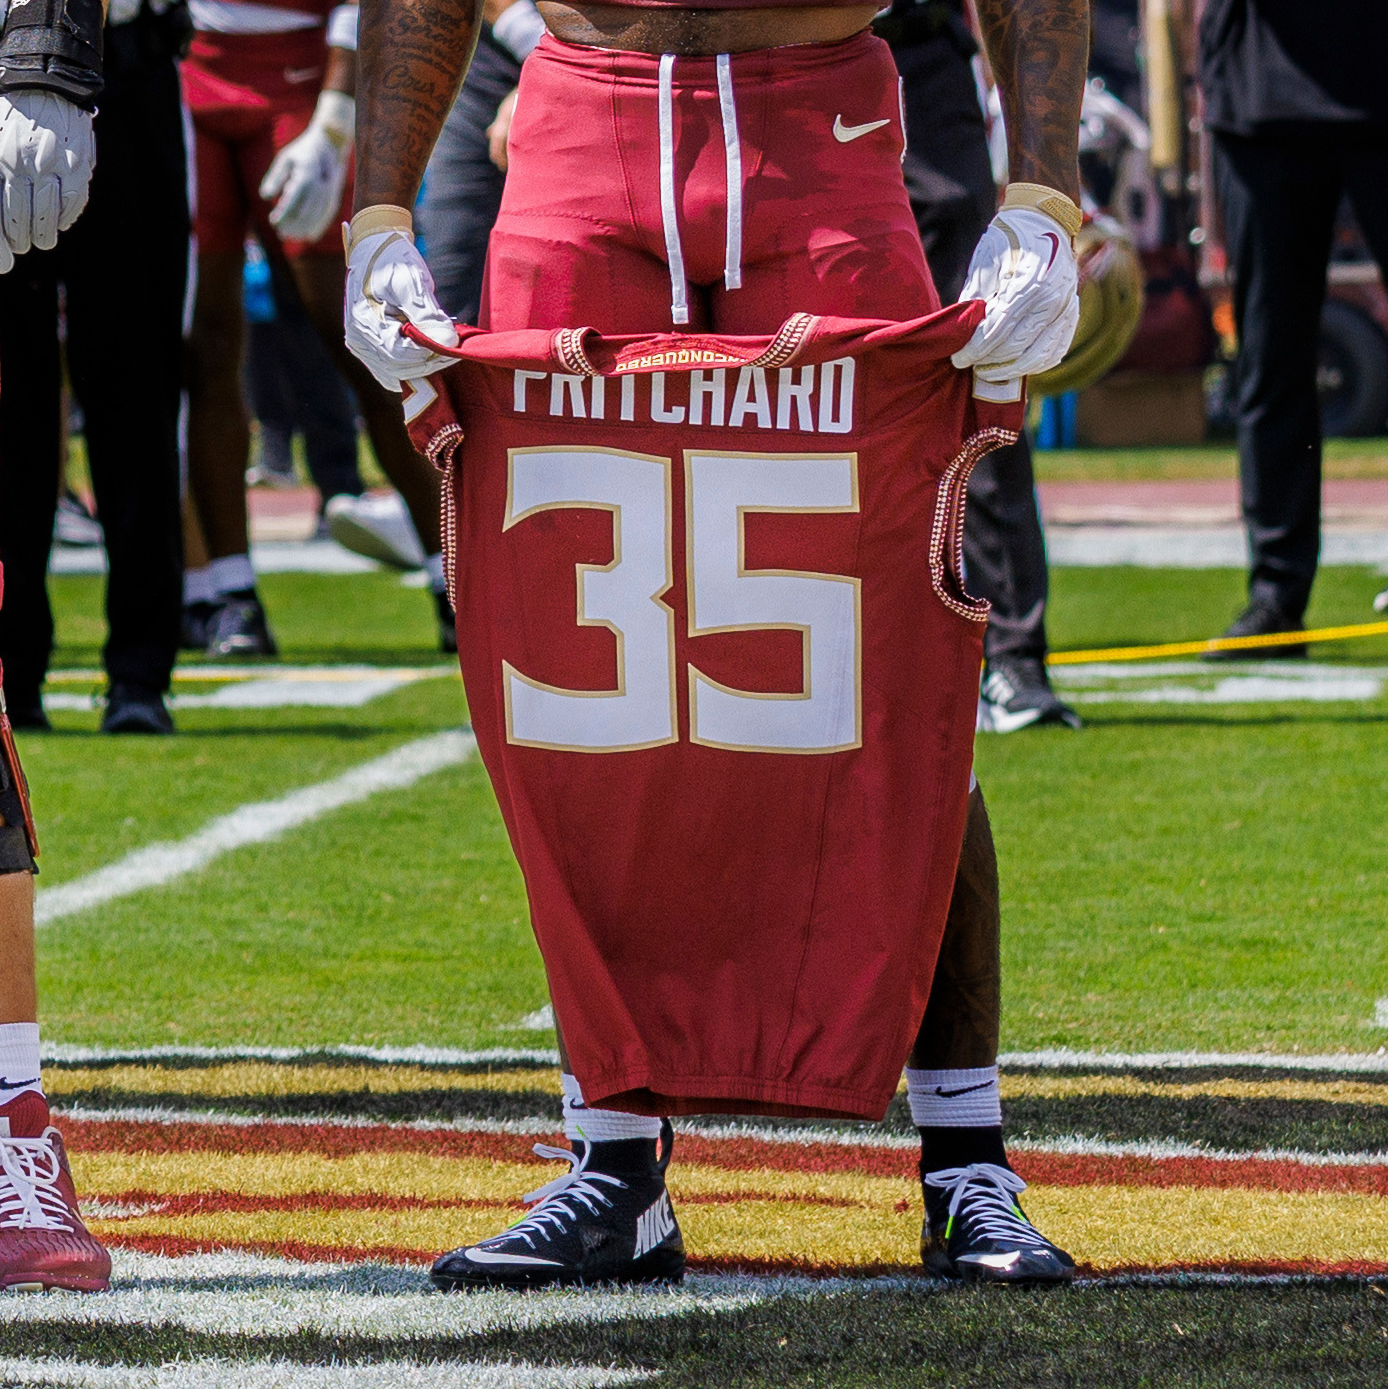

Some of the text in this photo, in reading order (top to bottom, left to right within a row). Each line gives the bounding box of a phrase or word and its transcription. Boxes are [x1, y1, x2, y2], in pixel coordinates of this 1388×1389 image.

[512, 356, 856, 434] PRITCHARD
[616, 349, 750, 372] CONQUERED
[502, 445, 863, 754] 35
[632, 1187, 676, 1260] NIKE
